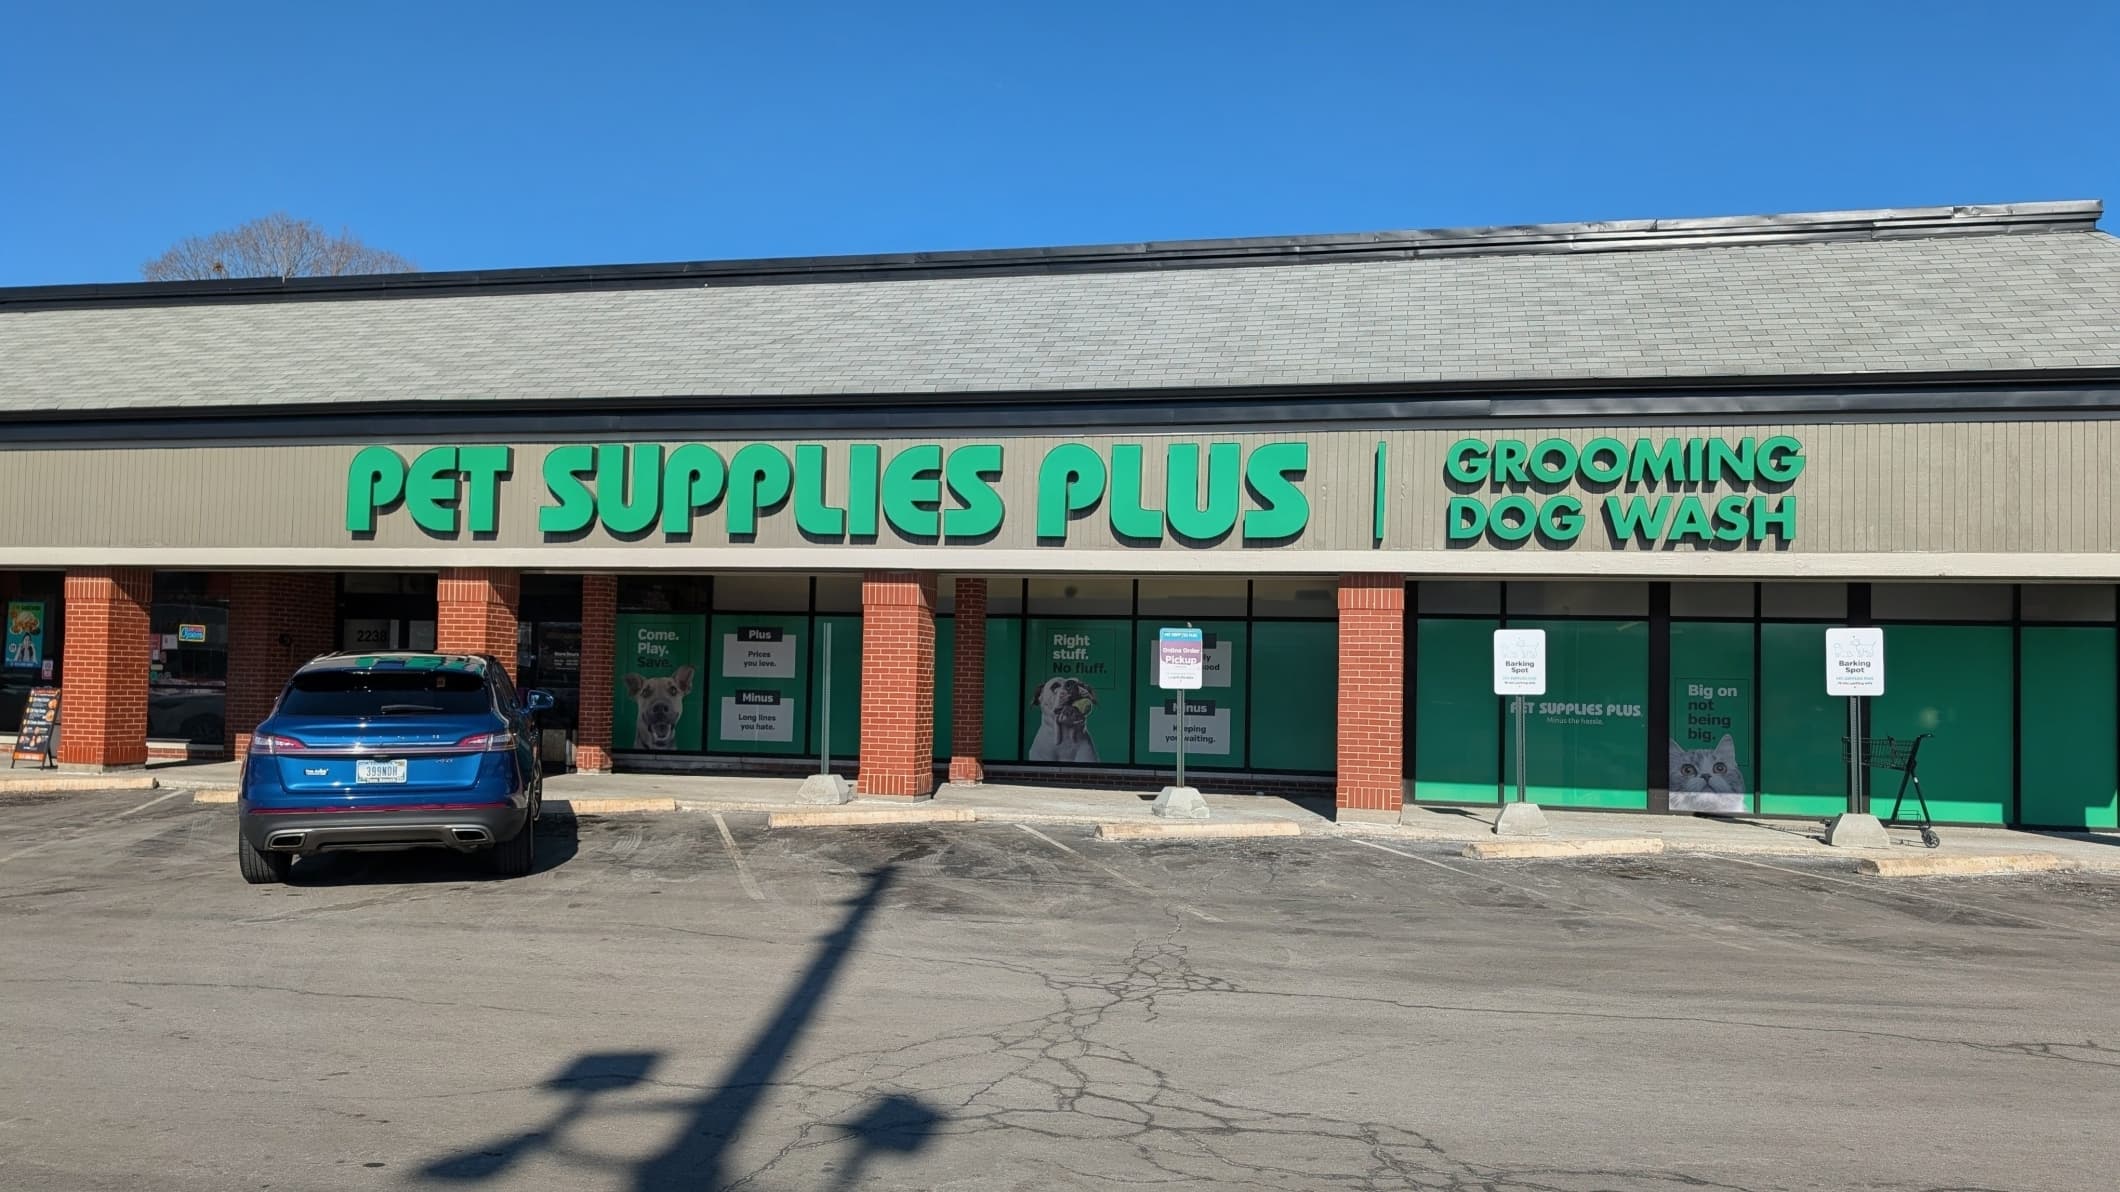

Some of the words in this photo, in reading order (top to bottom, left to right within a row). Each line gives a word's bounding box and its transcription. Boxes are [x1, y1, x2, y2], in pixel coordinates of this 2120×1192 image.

[1446, 435, 1806, 486] GROOMING
[346, 445, 510, 534] PET
[538, 443, 1005, 539] SUPPLIES
[1036, 442, 1311, 541] PLUS
[1449, 495, 1585, 543] DOG
[1605, 495, 1797, 543] WASH
[637, 628, 680, 641] Come.
[748, 629, 772, 640] Plus
[1053, 633, 1091, 648] Right
[637, 641, 670, 657] Play.
[747, 650, 771, 658] Prices
[1052, 647, 1089, 660] stuff.
[637, 656, 673, 668] Save.
[743, 660, 757, 668] you
[758, 659, 777, 667] love.
[1165, 655, 1198, 665] Pickup
[1505, 660, 1535, 668] Barking
[1838, 660, 1871, 668] Barking
[1053, 661, 1071, 674] No
[1074, 661, 1107, 674] fluff.
[742, 692, 774, 703] Minus
[1688, 684, 1713, 699] Big
[1717, 686, 1738, 697] on
[1539, 702, 1603, 716] SUPPLIES
[1606, 704, 1641, 717] PLUS
[1688, 699, 1715, 711] not
[738, 713, 757, 722] Long
[758, 713, 776, 721] lines
[1687, 713, 1731, 729] being
[740, 723, 754, 731] you
[756, 722, 775, 731] hate.
[1687, 727, 1717, 742] big.
